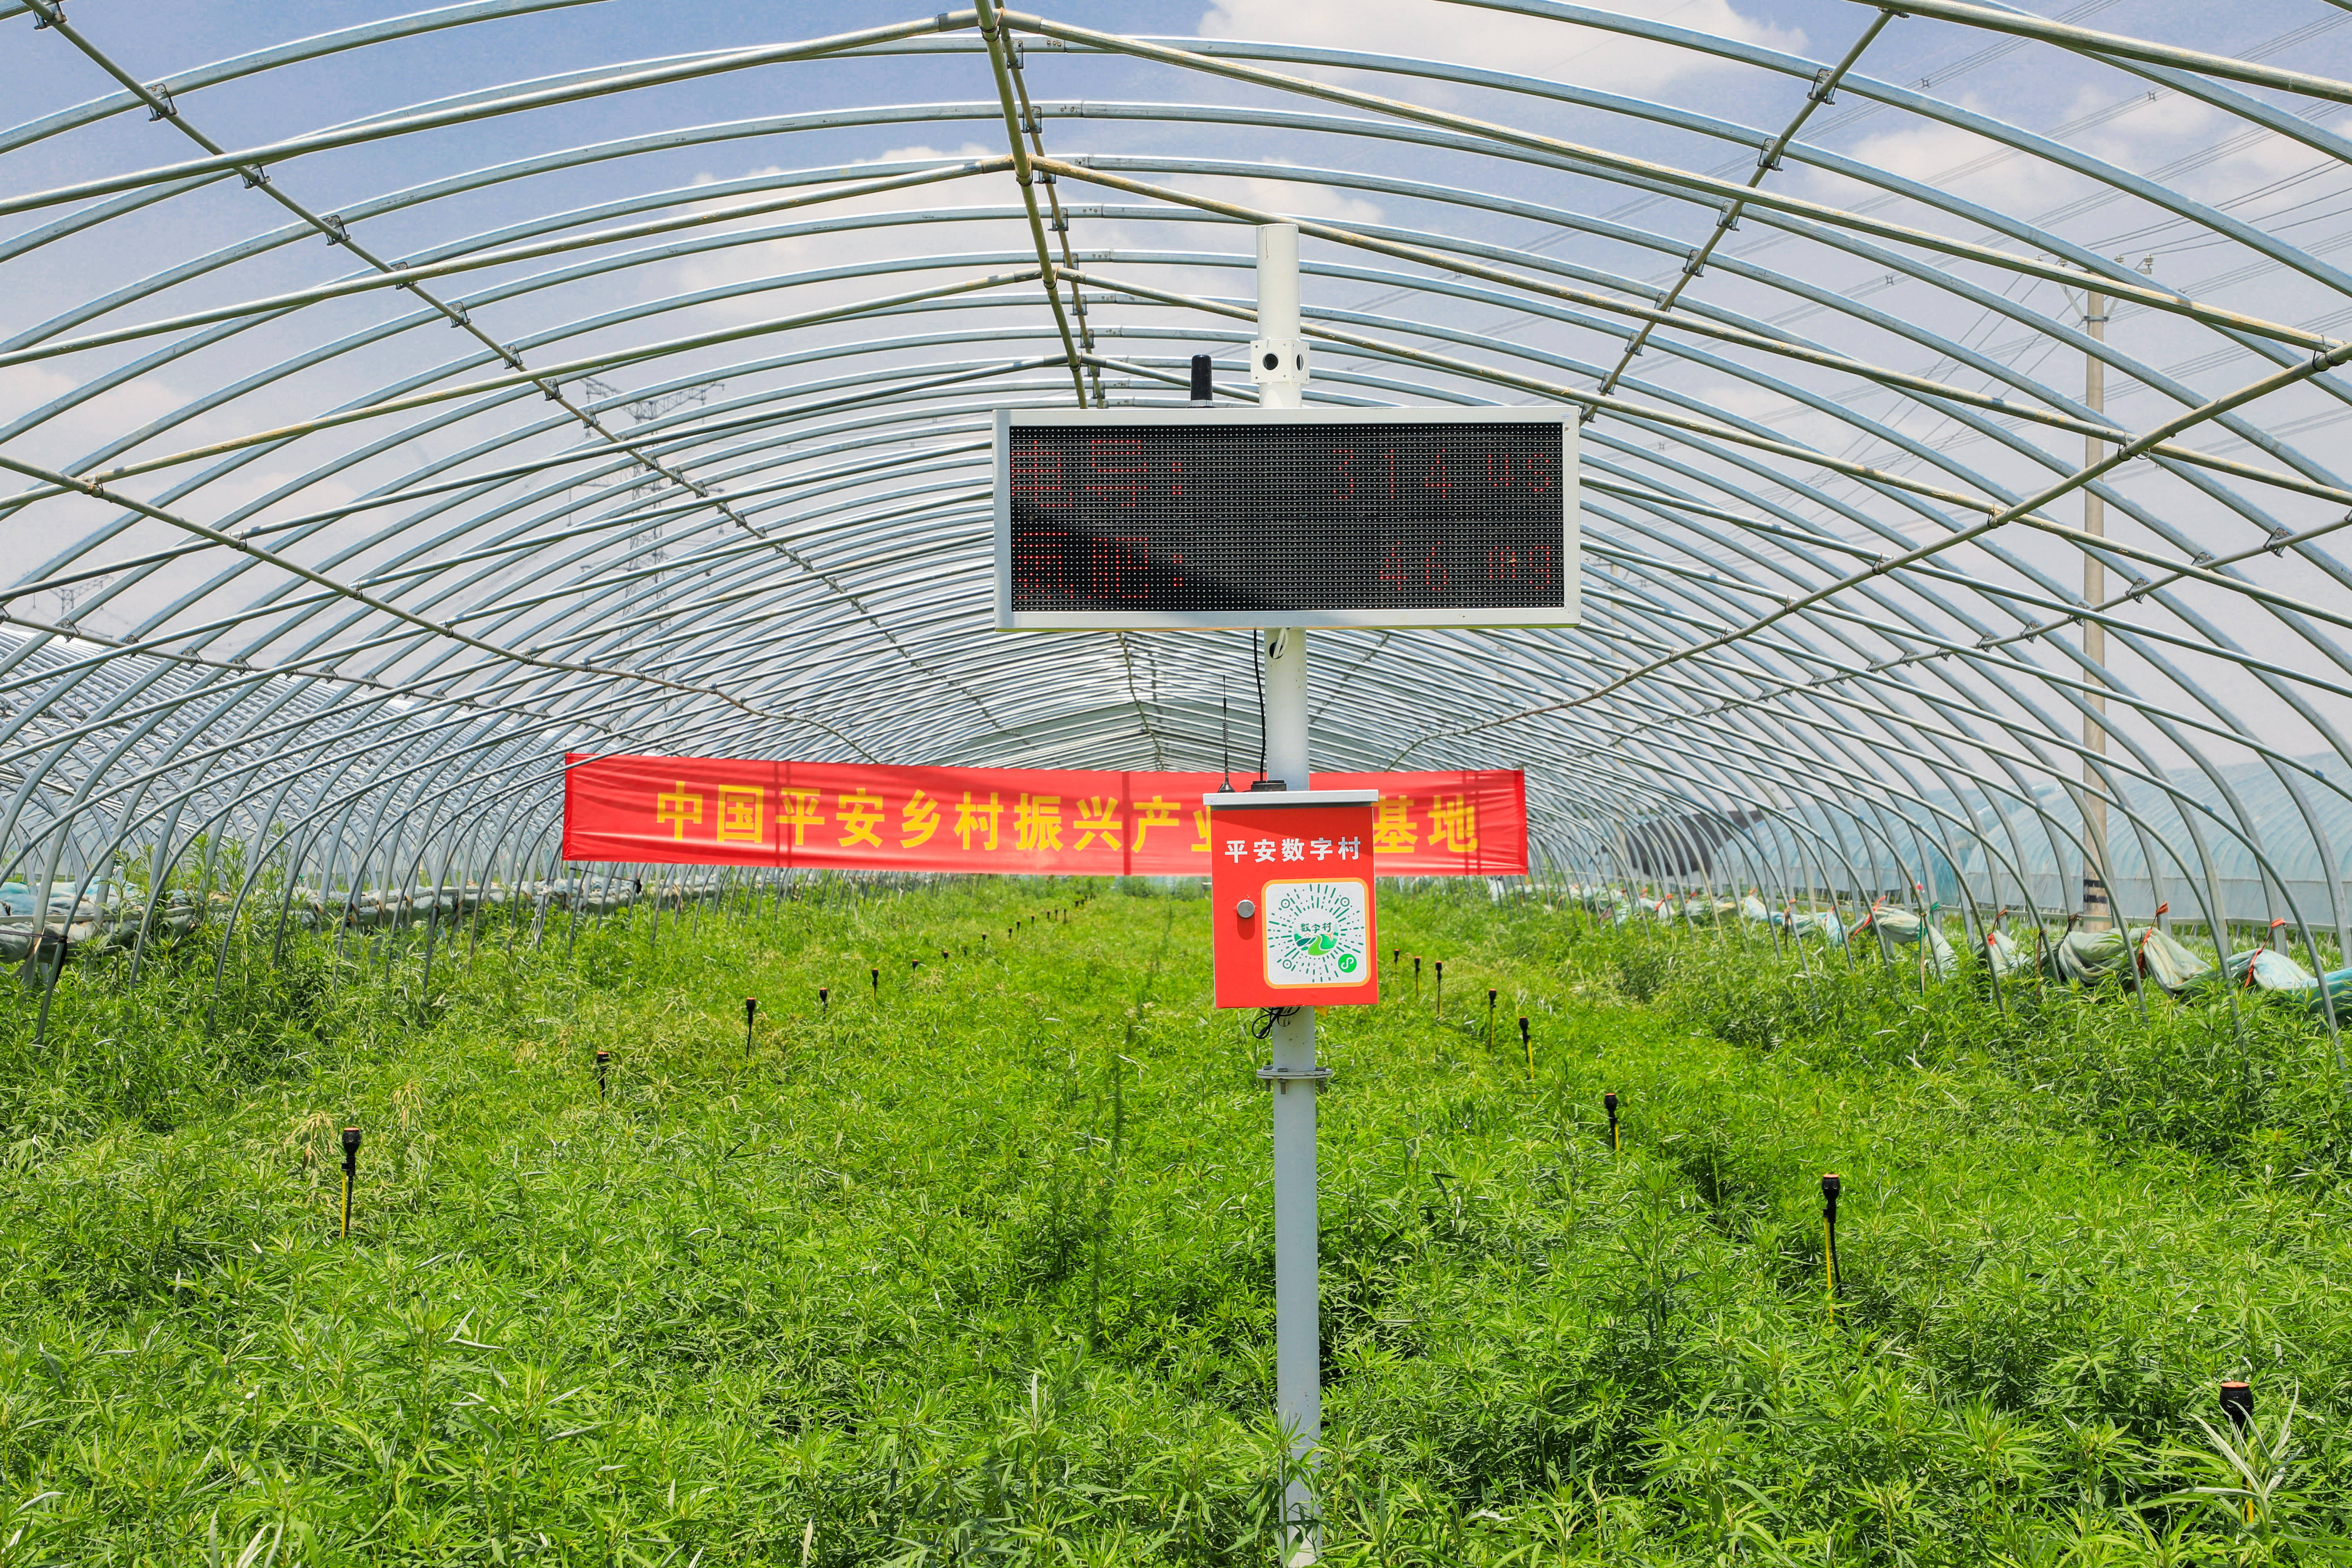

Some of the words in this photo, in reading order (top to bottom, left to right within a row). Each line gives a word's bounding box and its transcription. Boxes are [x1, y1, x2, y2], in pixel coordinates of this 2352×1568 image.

[1332, 449, 1452, 499] 314
[1379, 541, 1447, 590] 46
[1488, 545, 1550, 589] mg
[1224, 836, 1361, 864] 平安数字村
[1300, 922, 1332, 934] 数字村
